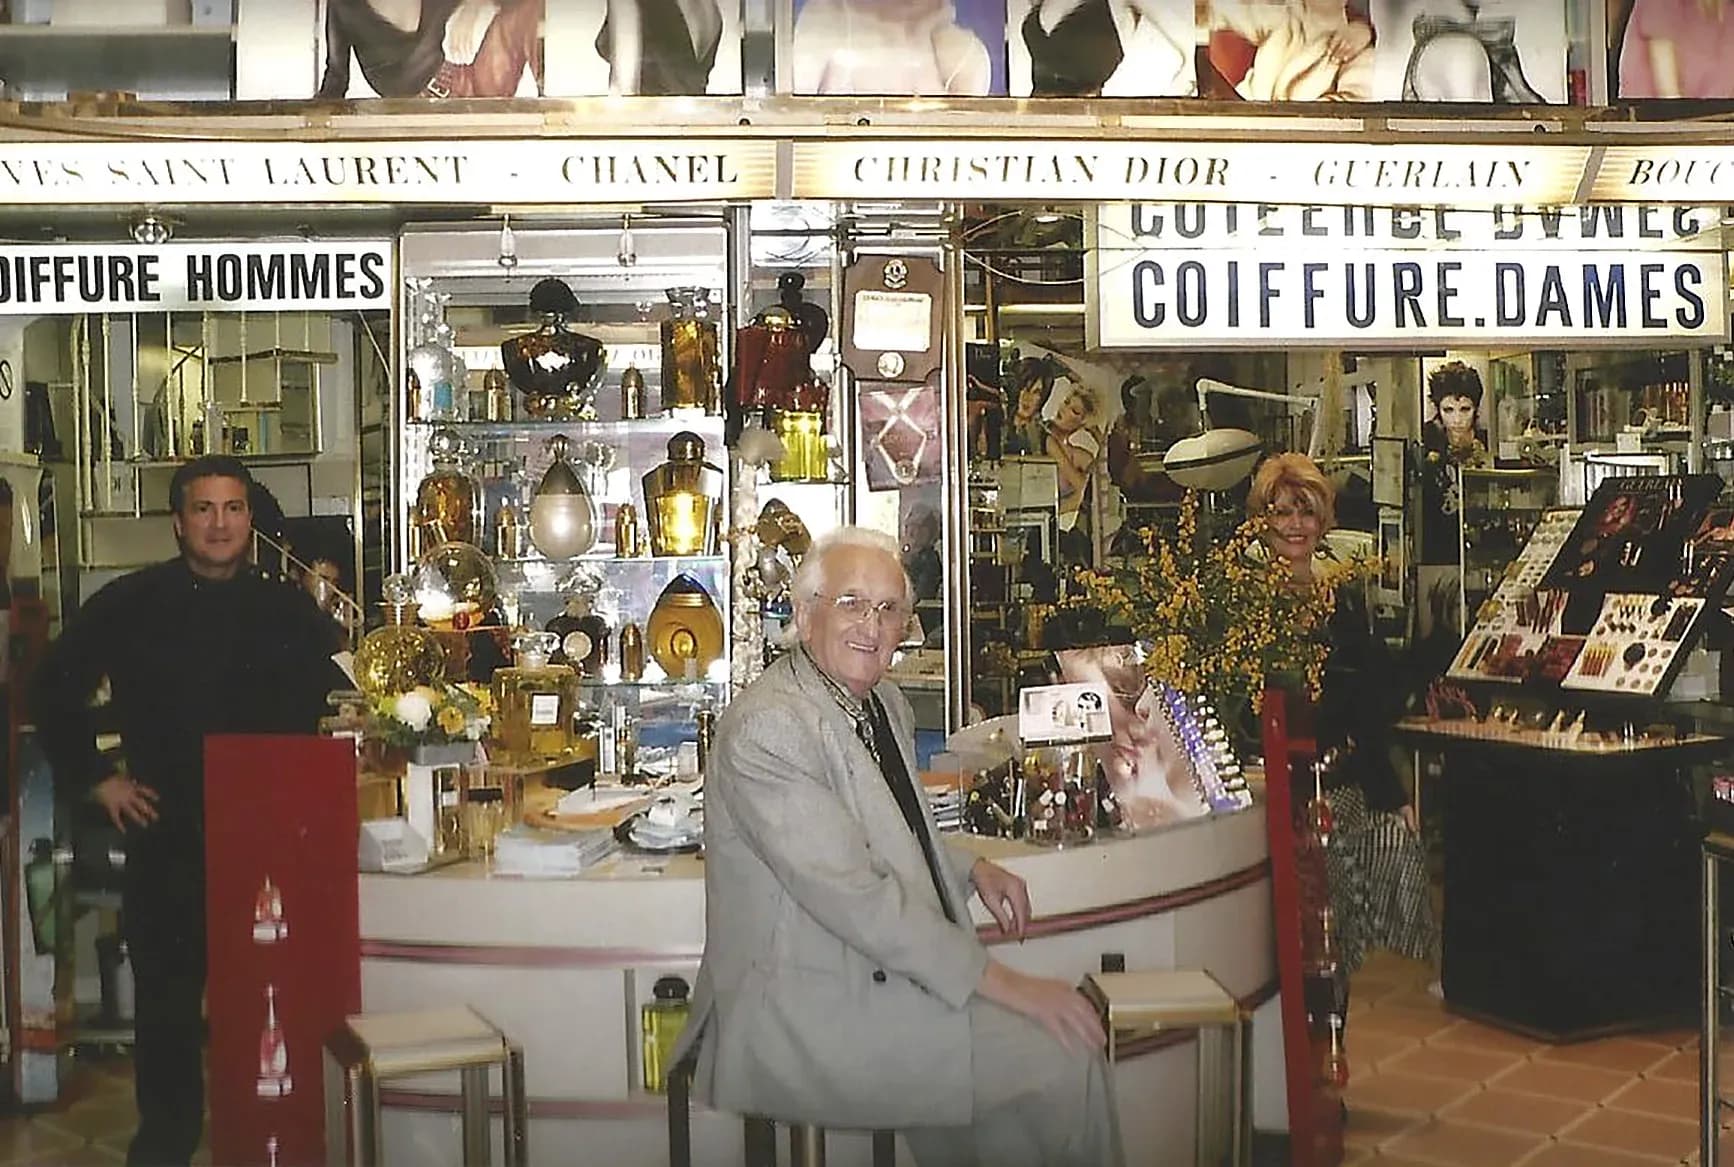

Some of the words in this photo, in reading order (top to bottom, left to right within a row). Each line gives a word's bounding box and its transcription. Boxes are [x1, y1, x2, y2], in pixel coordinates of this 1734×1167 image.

[107, 158, 236, 186] SAINT
[265, 156, 468, 186] LAURENT
[561, 155, 738, 184] CHANEL
[854, 155, 1099, 184] CHRISTIAN
[1125, 156, 1231, 186] DIOR
[1314, 160, 1532, 188] GUERLAIN
[187, 252, 384, 301] HOMMES
